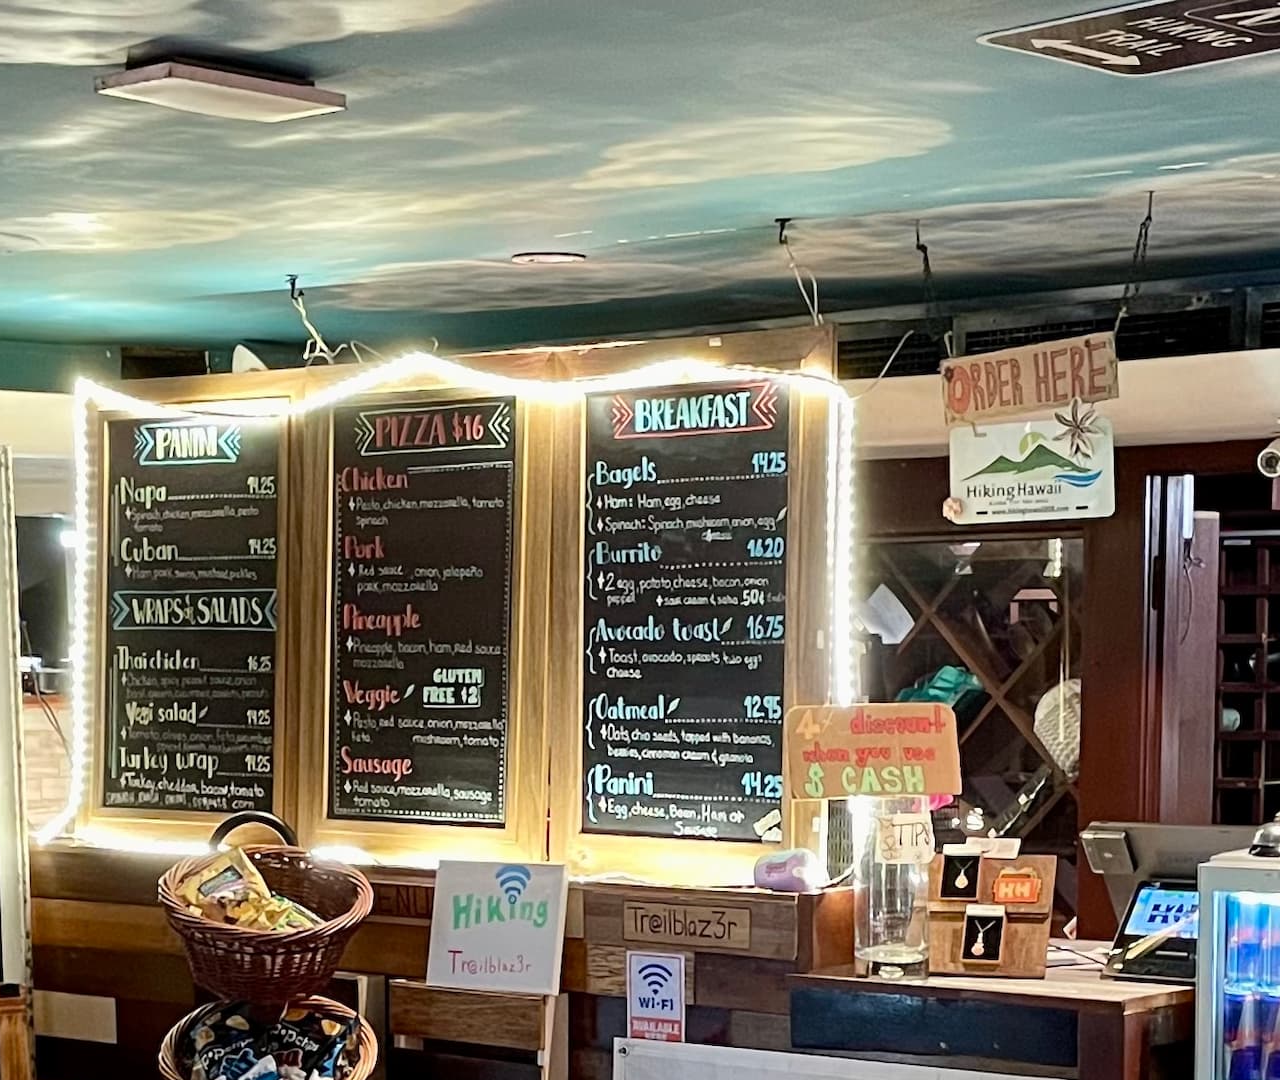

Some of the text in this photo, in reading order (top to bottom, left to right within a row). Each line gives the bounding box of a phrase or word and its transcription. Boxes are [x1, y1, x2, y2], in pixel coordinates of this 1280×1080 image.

[1083, 30, 1183, 57] TRAIL
[1125, 16, 1254, 49] HIKING
[948, 339, 1107, 414] ORDER HERE
[634, 391, 750, 433] BREAKFAST
[376, 411, 484, 447] PIZZA $16
[342, 467, 408, 492] Chicken
[596, 456, 656, 489] Bagels
[120, 477, 167, 509] Napa
[967, 483, 1062, 500] Hiking Hawaii
[121, 537, 179, 562] Cuban
[345, 536, 384, 559] Pork
[596, 541, 662, 565] Burrito
[132, 597, 263, 625] WRAPS SALADS
[343, 603, 421, 636] Pineapple
[595, 615, 665, 643] Avocado
[433, 668, 482, 683] GLUTEN
[343, 680, 401, 711] Veggie
[423, 686, 455, 704] FREE
[595, 693, 665, 720] Oatmeal
[158, 702, 196, 724] salad
[850, 705, 946, 735] discount
[176, 752, 219, 779] wrap
[341, 746, 413, 782] Sausage
[595, 764, 654, 795] Panini
[842, 765, 925, 793] CASH
